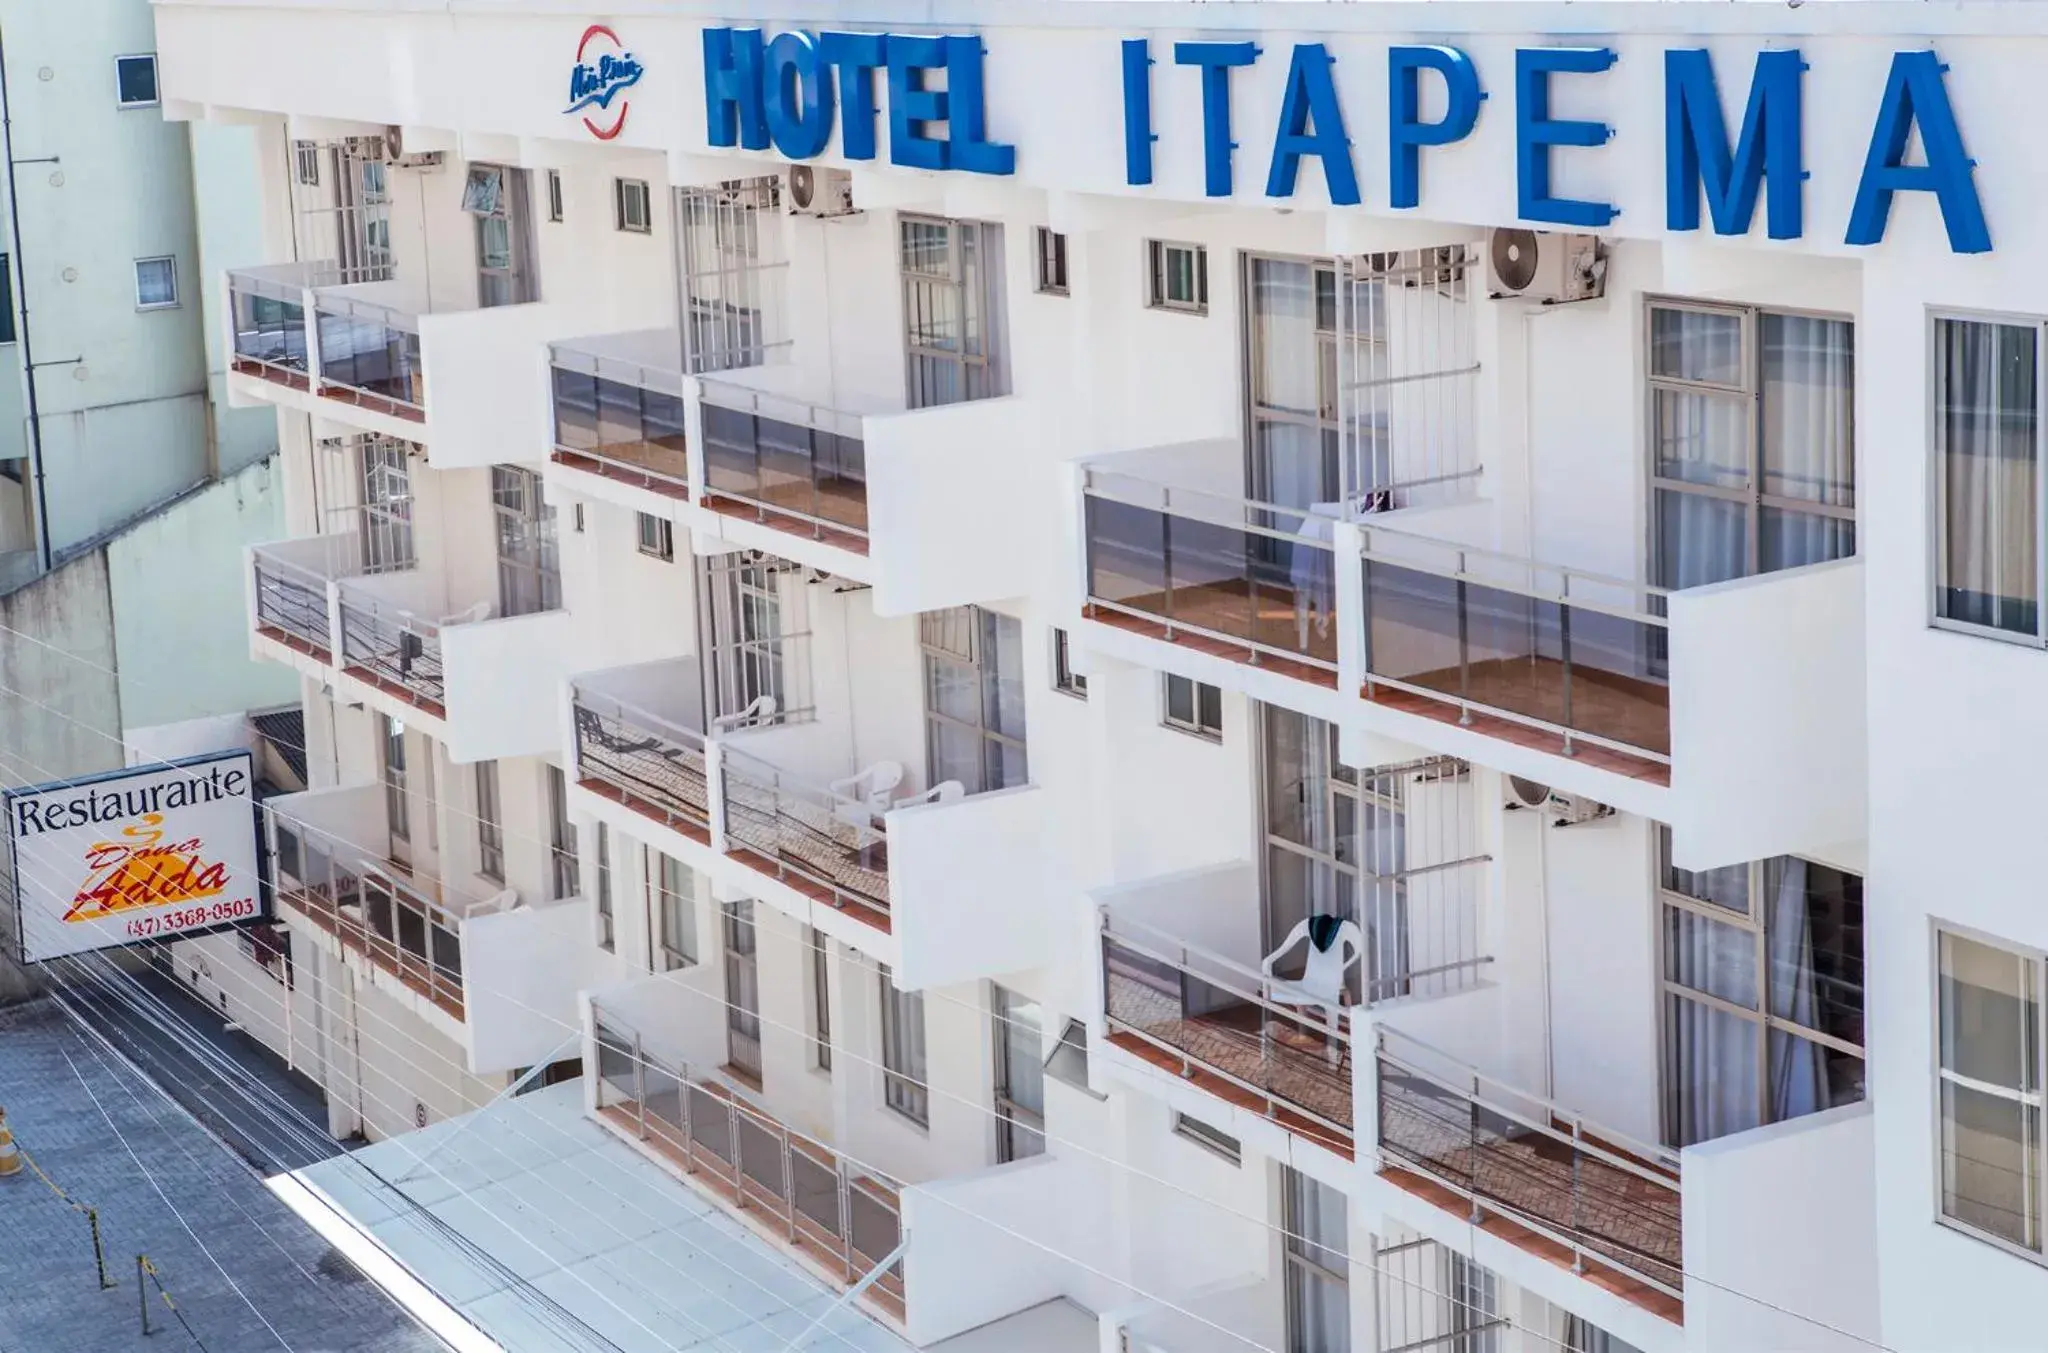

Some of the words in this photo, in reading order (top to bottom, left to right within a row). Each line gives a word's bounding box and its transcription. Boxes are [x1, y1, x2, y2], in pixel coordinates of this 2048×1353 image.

[702, 28, 1015, 175] HOTEL
[1122, 40, 1993, 254] ITAPEMA
[18, 767, 246, 837] Restaurante
[62, 855, 231, 922] Adda
[127, 918, 161, 938] (47)
[163, 898, 254, 931] 3368-0503
